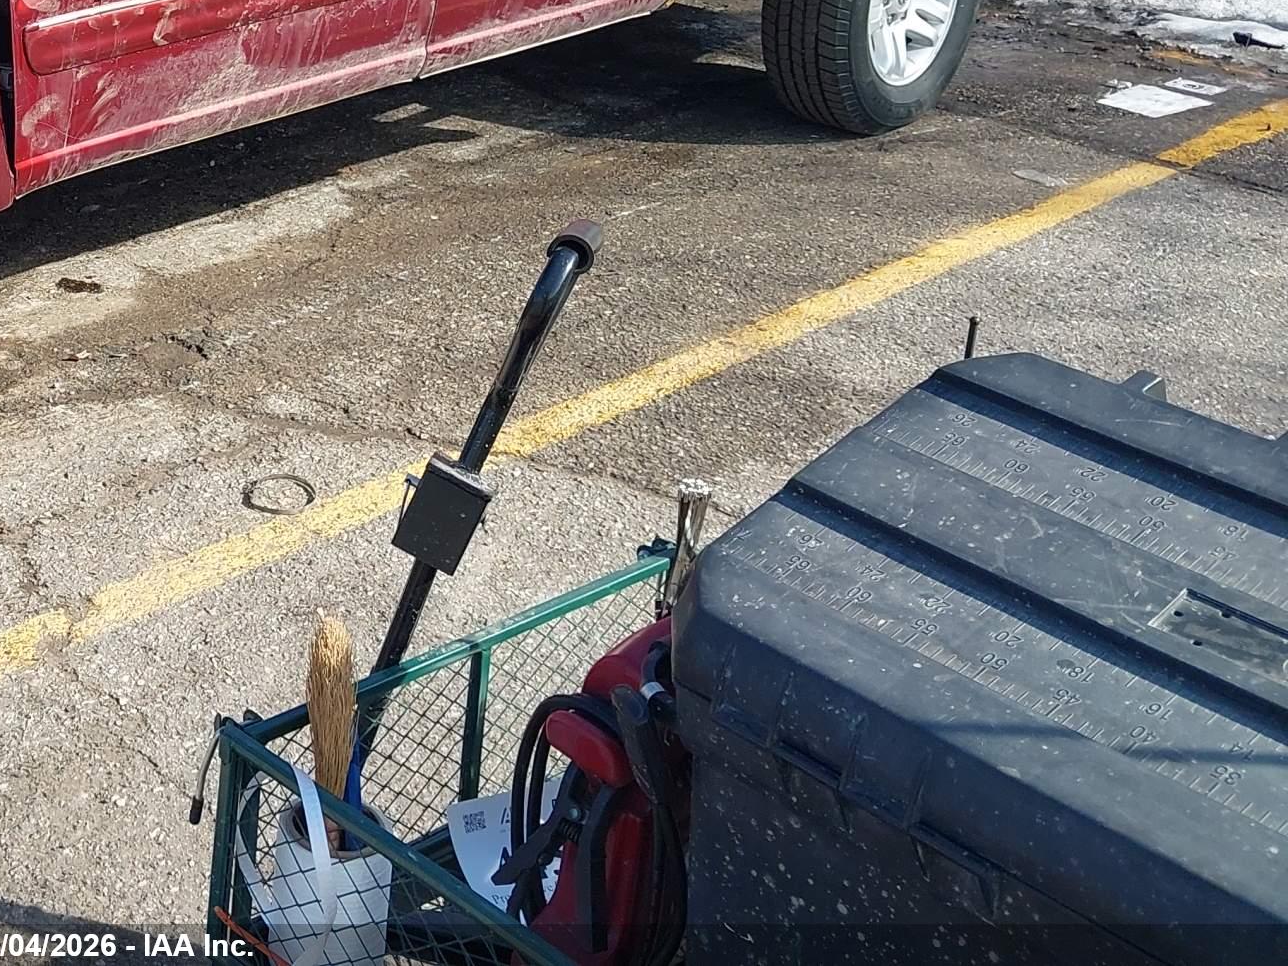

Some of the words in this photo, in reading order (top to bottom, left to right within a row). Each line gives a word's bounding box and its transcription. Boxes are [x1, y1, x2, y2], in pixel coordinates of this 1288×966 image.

[1003, 458, 1031, 474] 60
[1139, 515, 1168, 533] 50
[846, 586, 872, 603] 60
[911, 618, 938, 636] 55
[980, 652, 1010, 671] 50
[1052, 688, 1082, 707] 45
[1129, 725, 1161, 746] 40
[1209, 764, 1242, 786] 35
